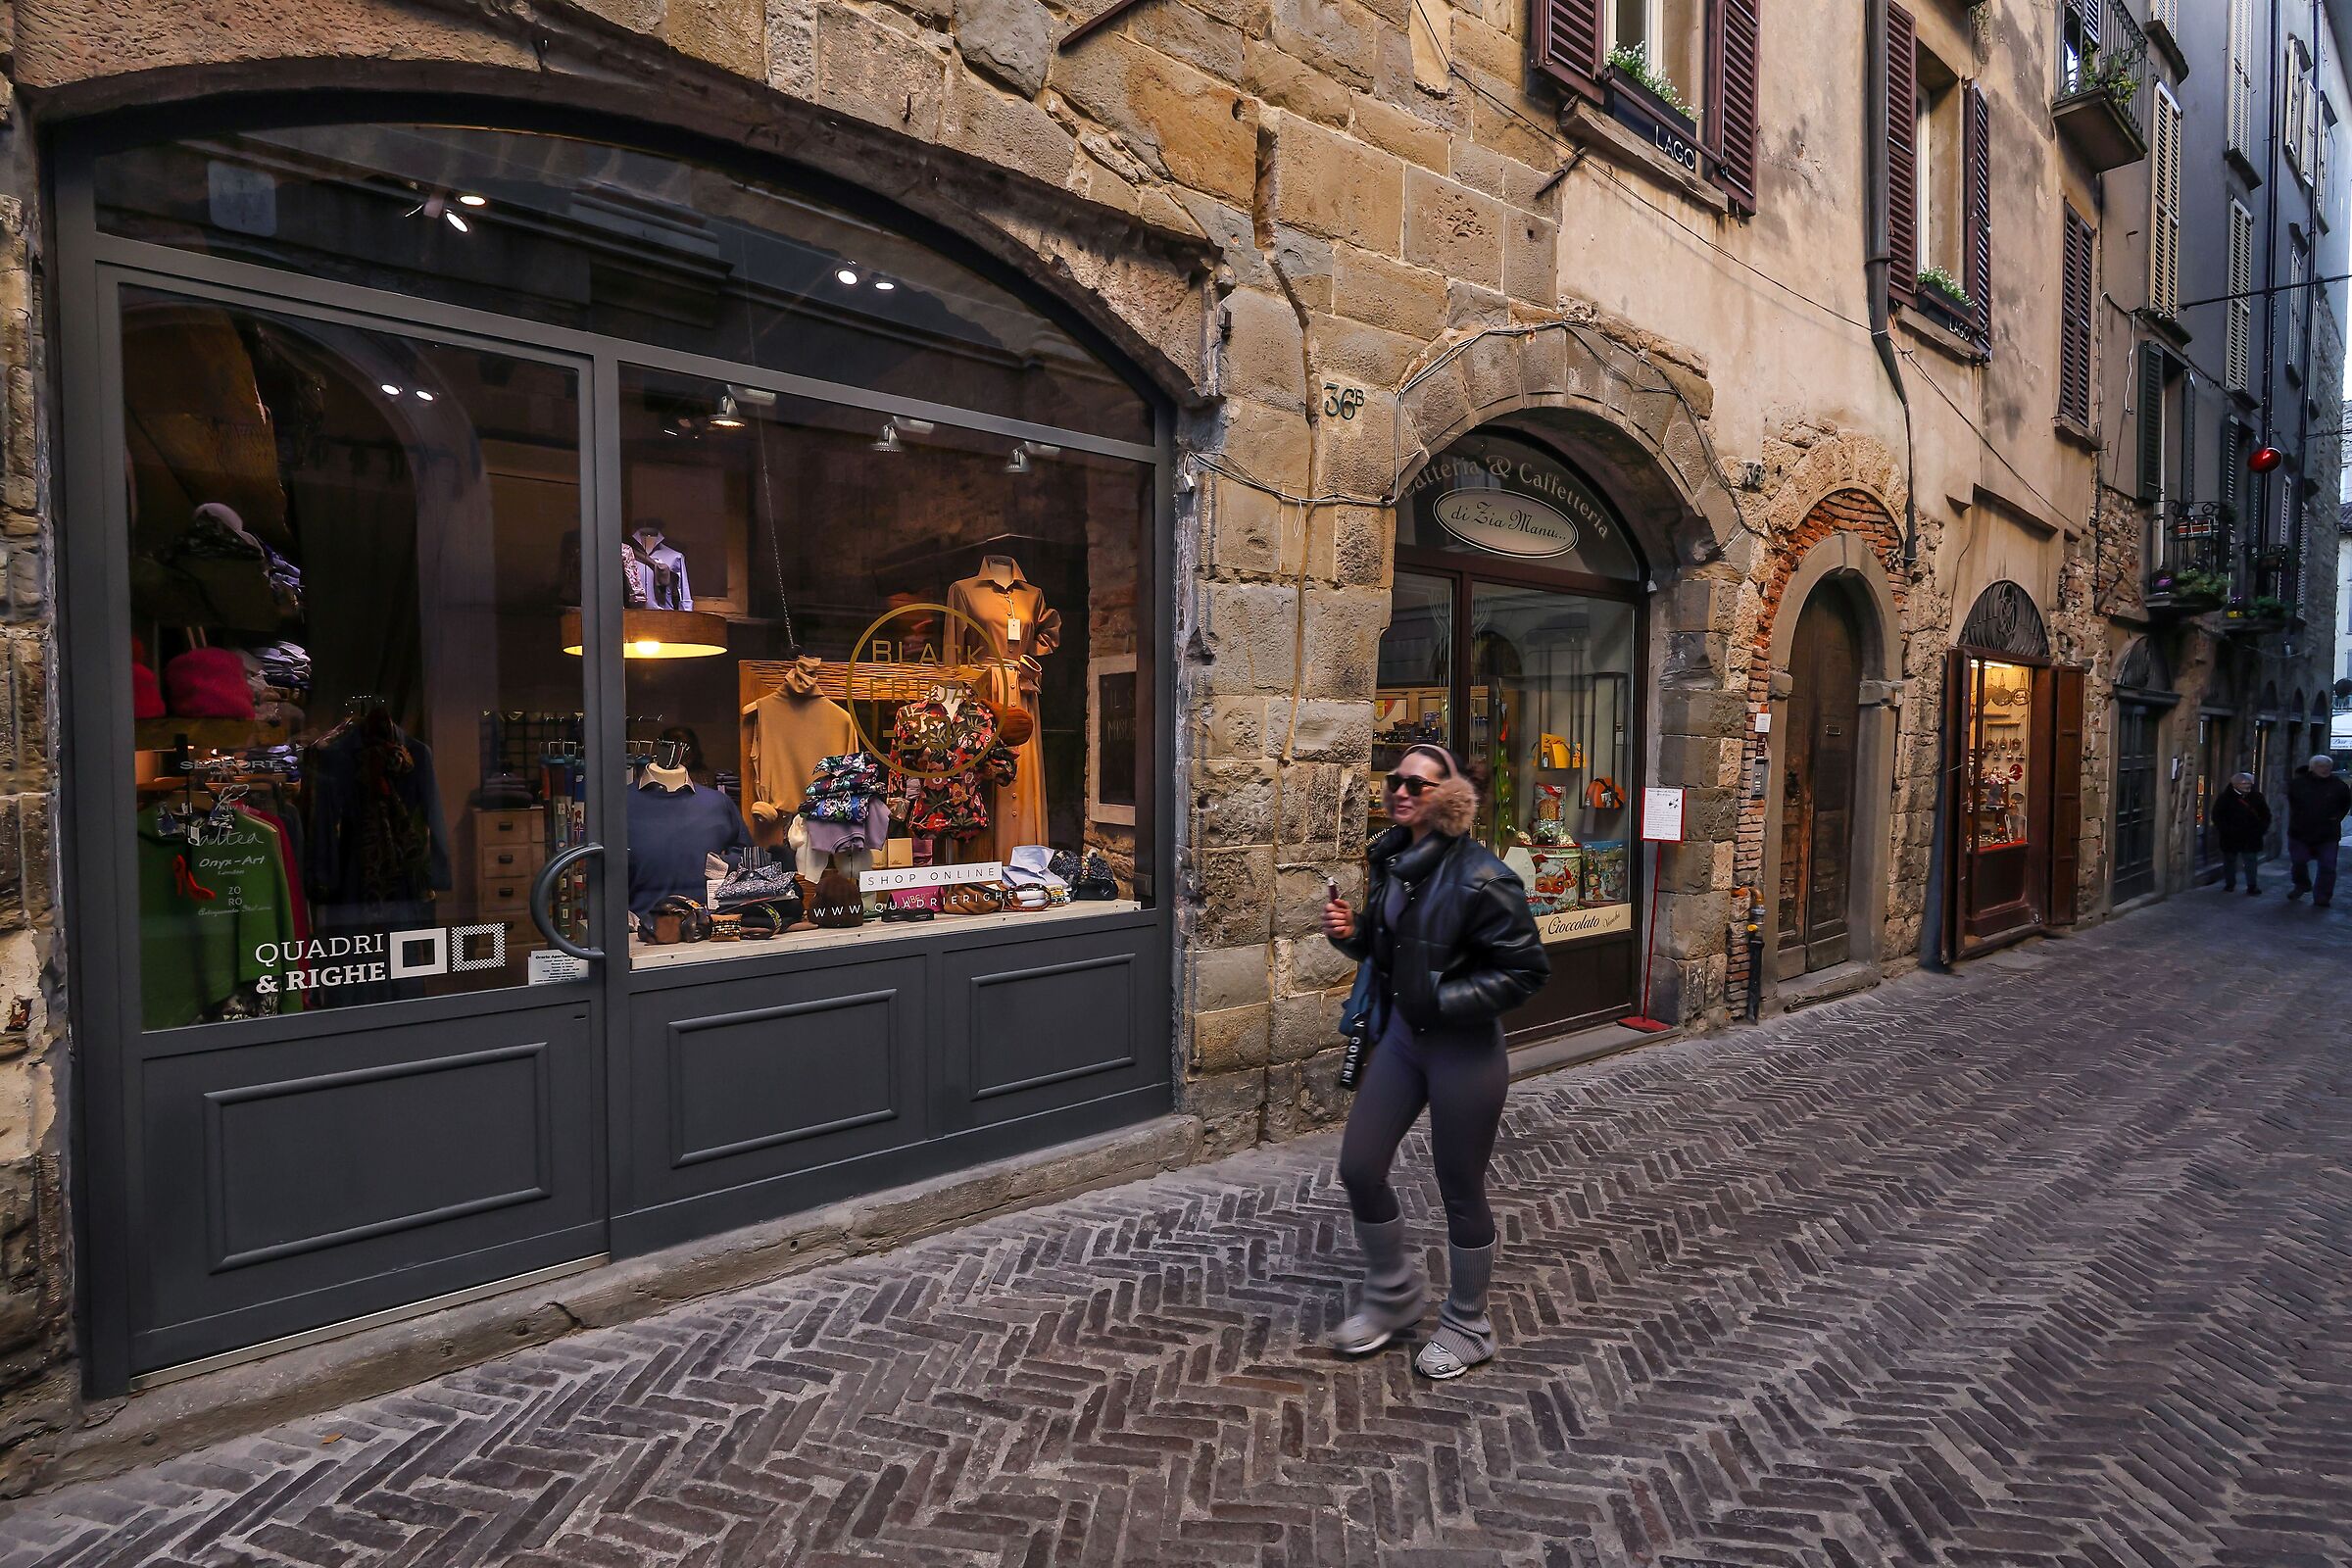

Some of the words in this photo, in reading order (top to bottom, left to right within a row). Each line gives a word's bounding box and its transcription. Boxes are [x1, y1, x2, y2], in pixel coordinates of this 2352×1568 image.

[1655, 124, 1695, 170] LAGO
[1486, 455, 1512, 480] &
[1519, 462, 1608, 539] Caffetteria
[1450, 505, 1470, 521] di
[1473, 501, 1505, 529] Zia
[871, 639, 984, 669] BLACK
[868, 678, 986, 705] FRIDA
[199, 856, 266, 869] Onyx-Art
[867, 873, 916, 886] SHOP
[930, 867, 995, 881] ONLINE
[227, 886, 241, 895] ZO
[227, 897, 243, 906] RO
[1547, 914, 1600, 935] Cioccolato
[255, 933, 384, 967] QUADRI
[255, 974, 279, 994] &
[285, 961, 386, 991] RIGHE
